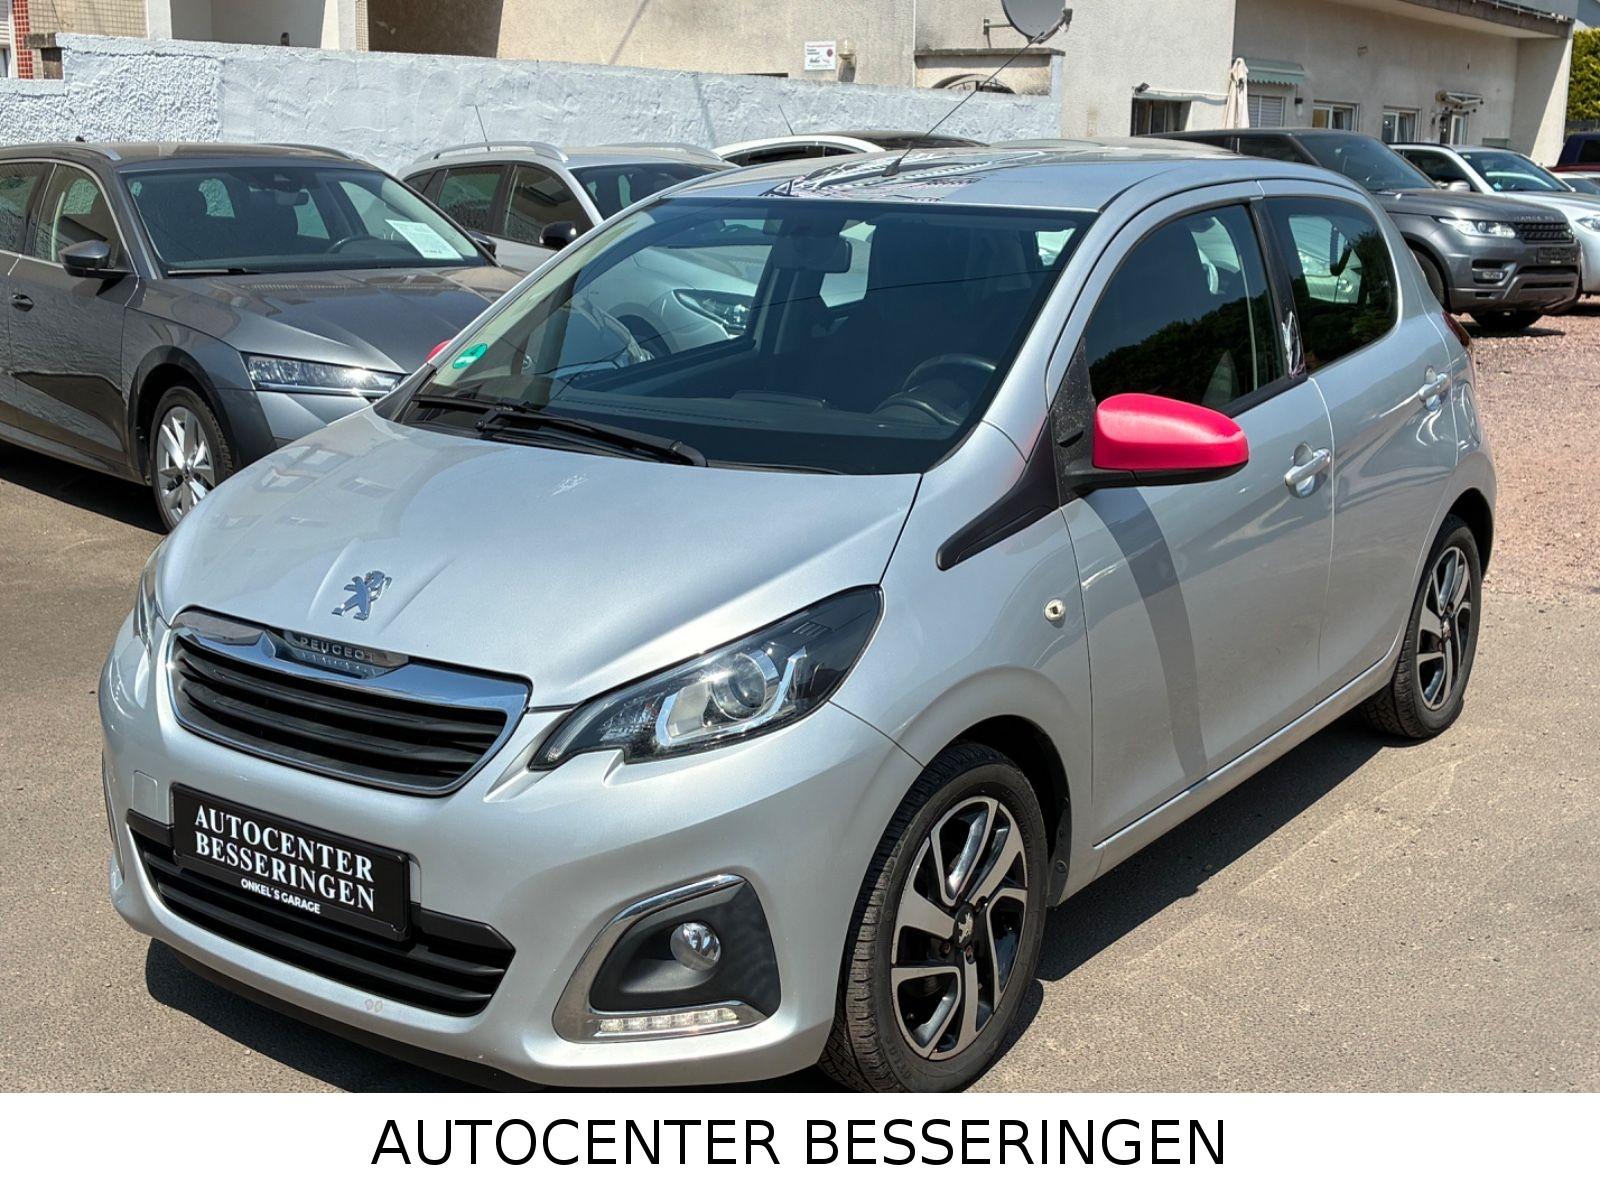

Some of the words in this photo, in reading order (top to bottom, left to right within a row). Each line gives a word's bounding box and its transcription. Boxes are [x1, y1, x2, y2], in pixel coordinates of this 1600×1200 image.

[195, 805, 374, 883] AUTOCENTER
[195, 831, 375, 912] BESSERINGEN
[281, 892, 321, 915] GARAGE
